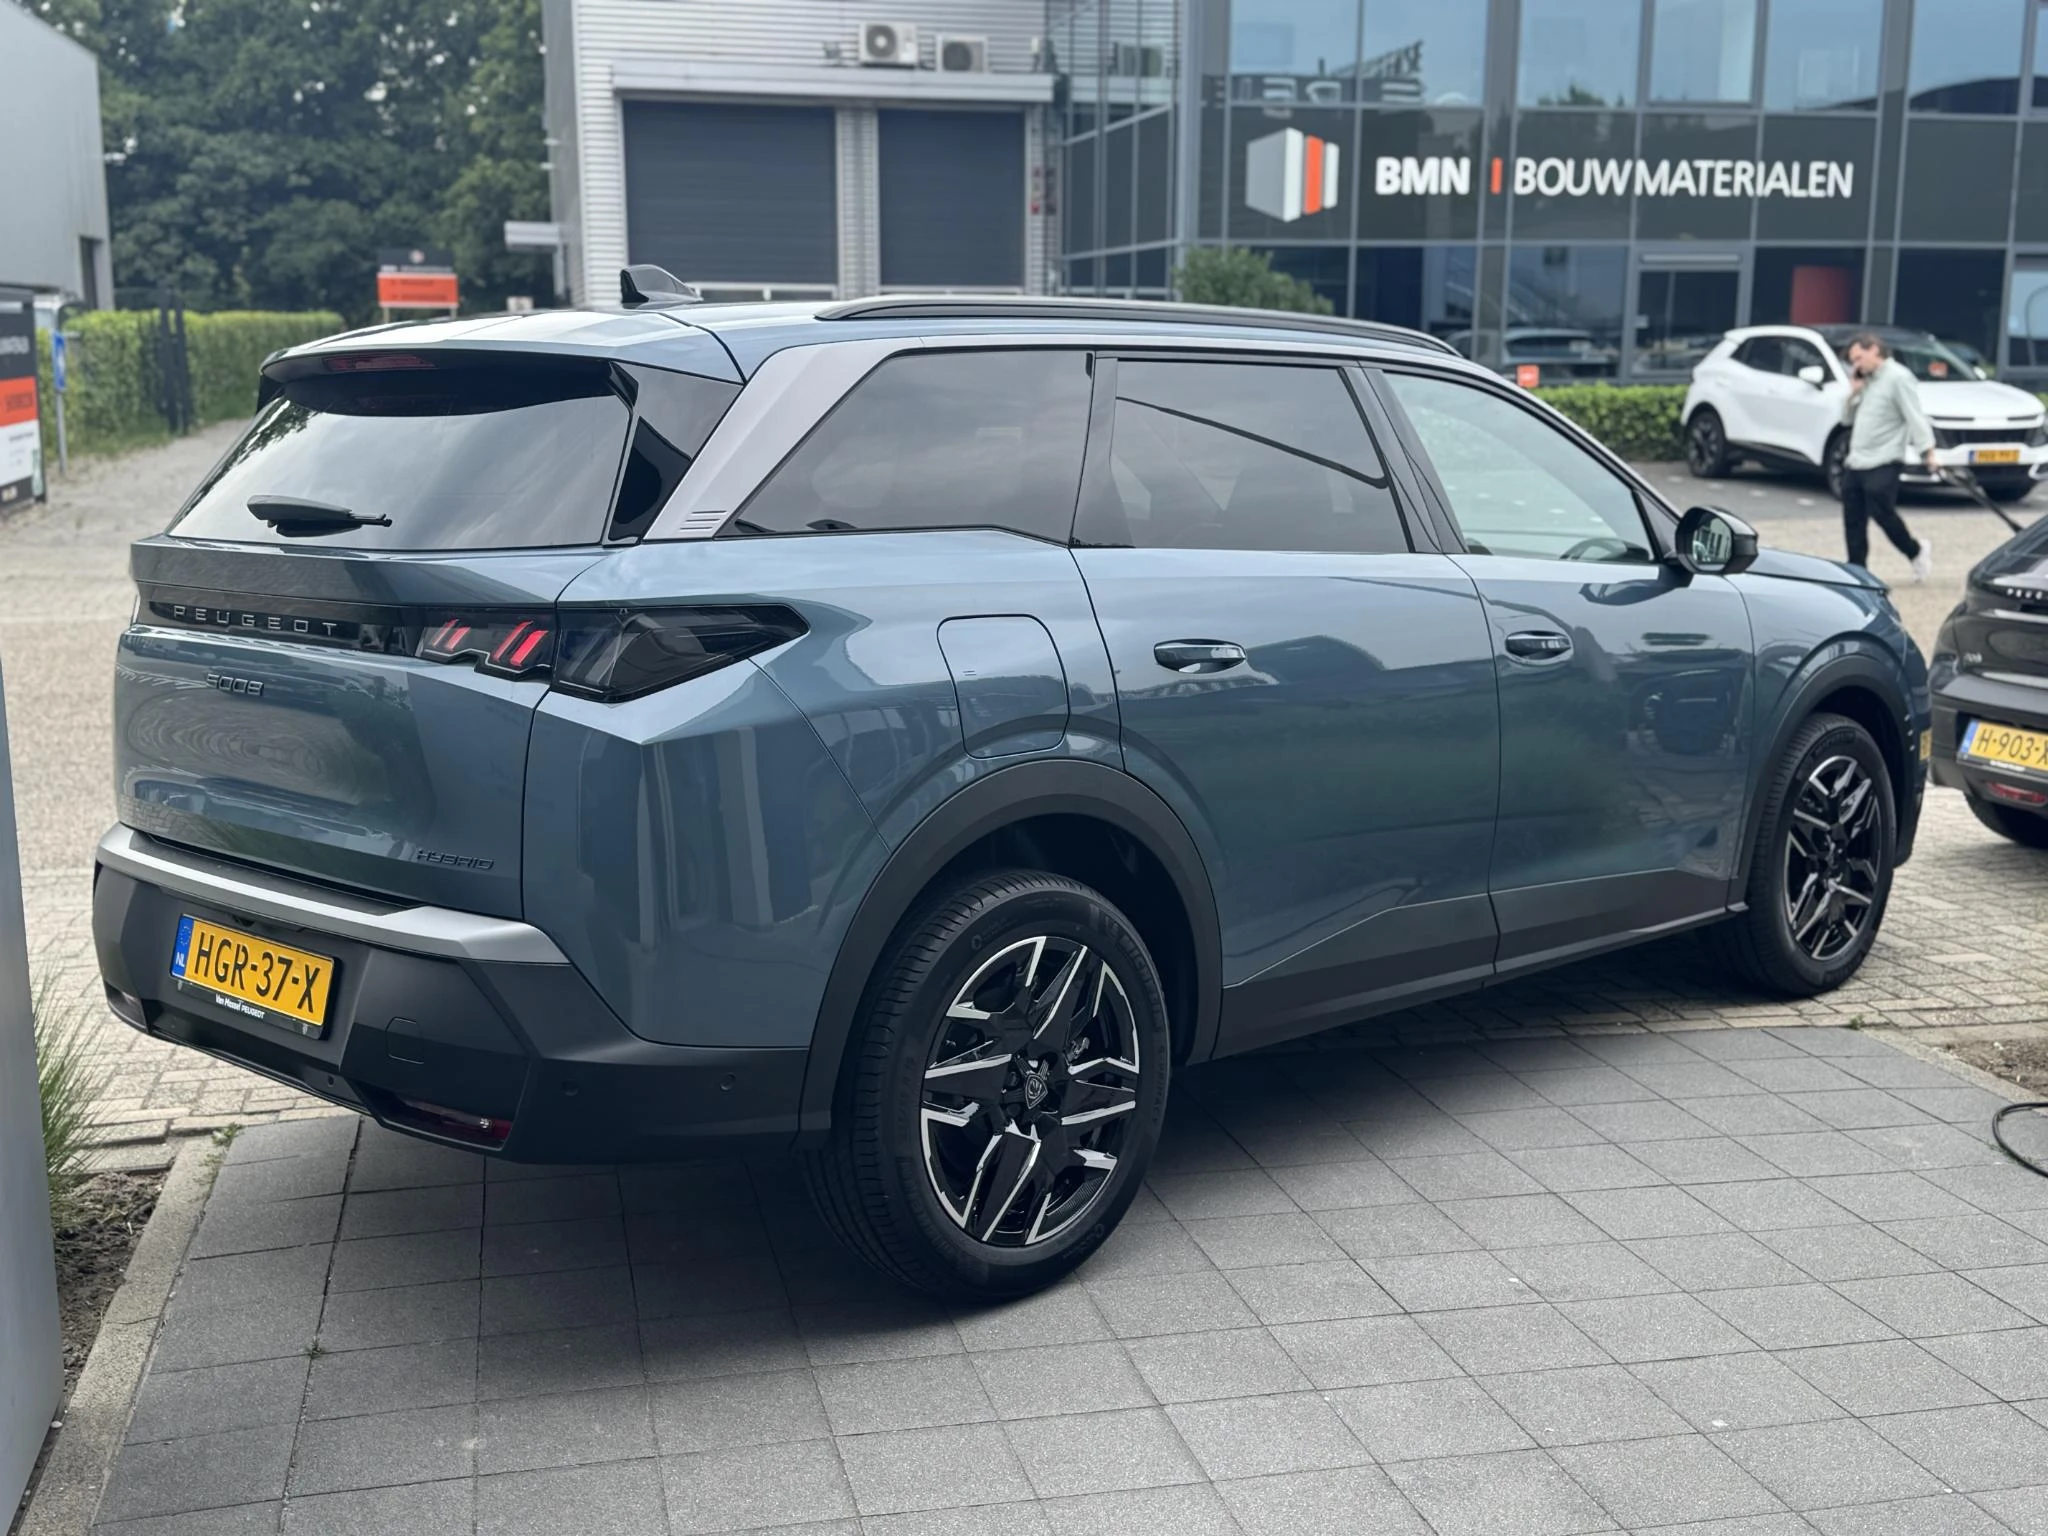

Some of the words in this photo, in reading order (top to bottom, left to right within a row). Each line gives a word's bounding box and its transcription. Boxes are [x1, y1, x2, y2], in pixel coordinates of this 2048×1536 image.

[1375, 156, 1471, 196] BMN
[1514, 157, 1855, 198] BOUWMATERIALEN
[173, 605, 337, 636] PEUGEOT
[206, 673, 264, 697] 5008
[416, 848, 495, 870] HYBRID
[175, 951, 185, 968] NL
[194, 931, 321, 1013] HGR-37-X
